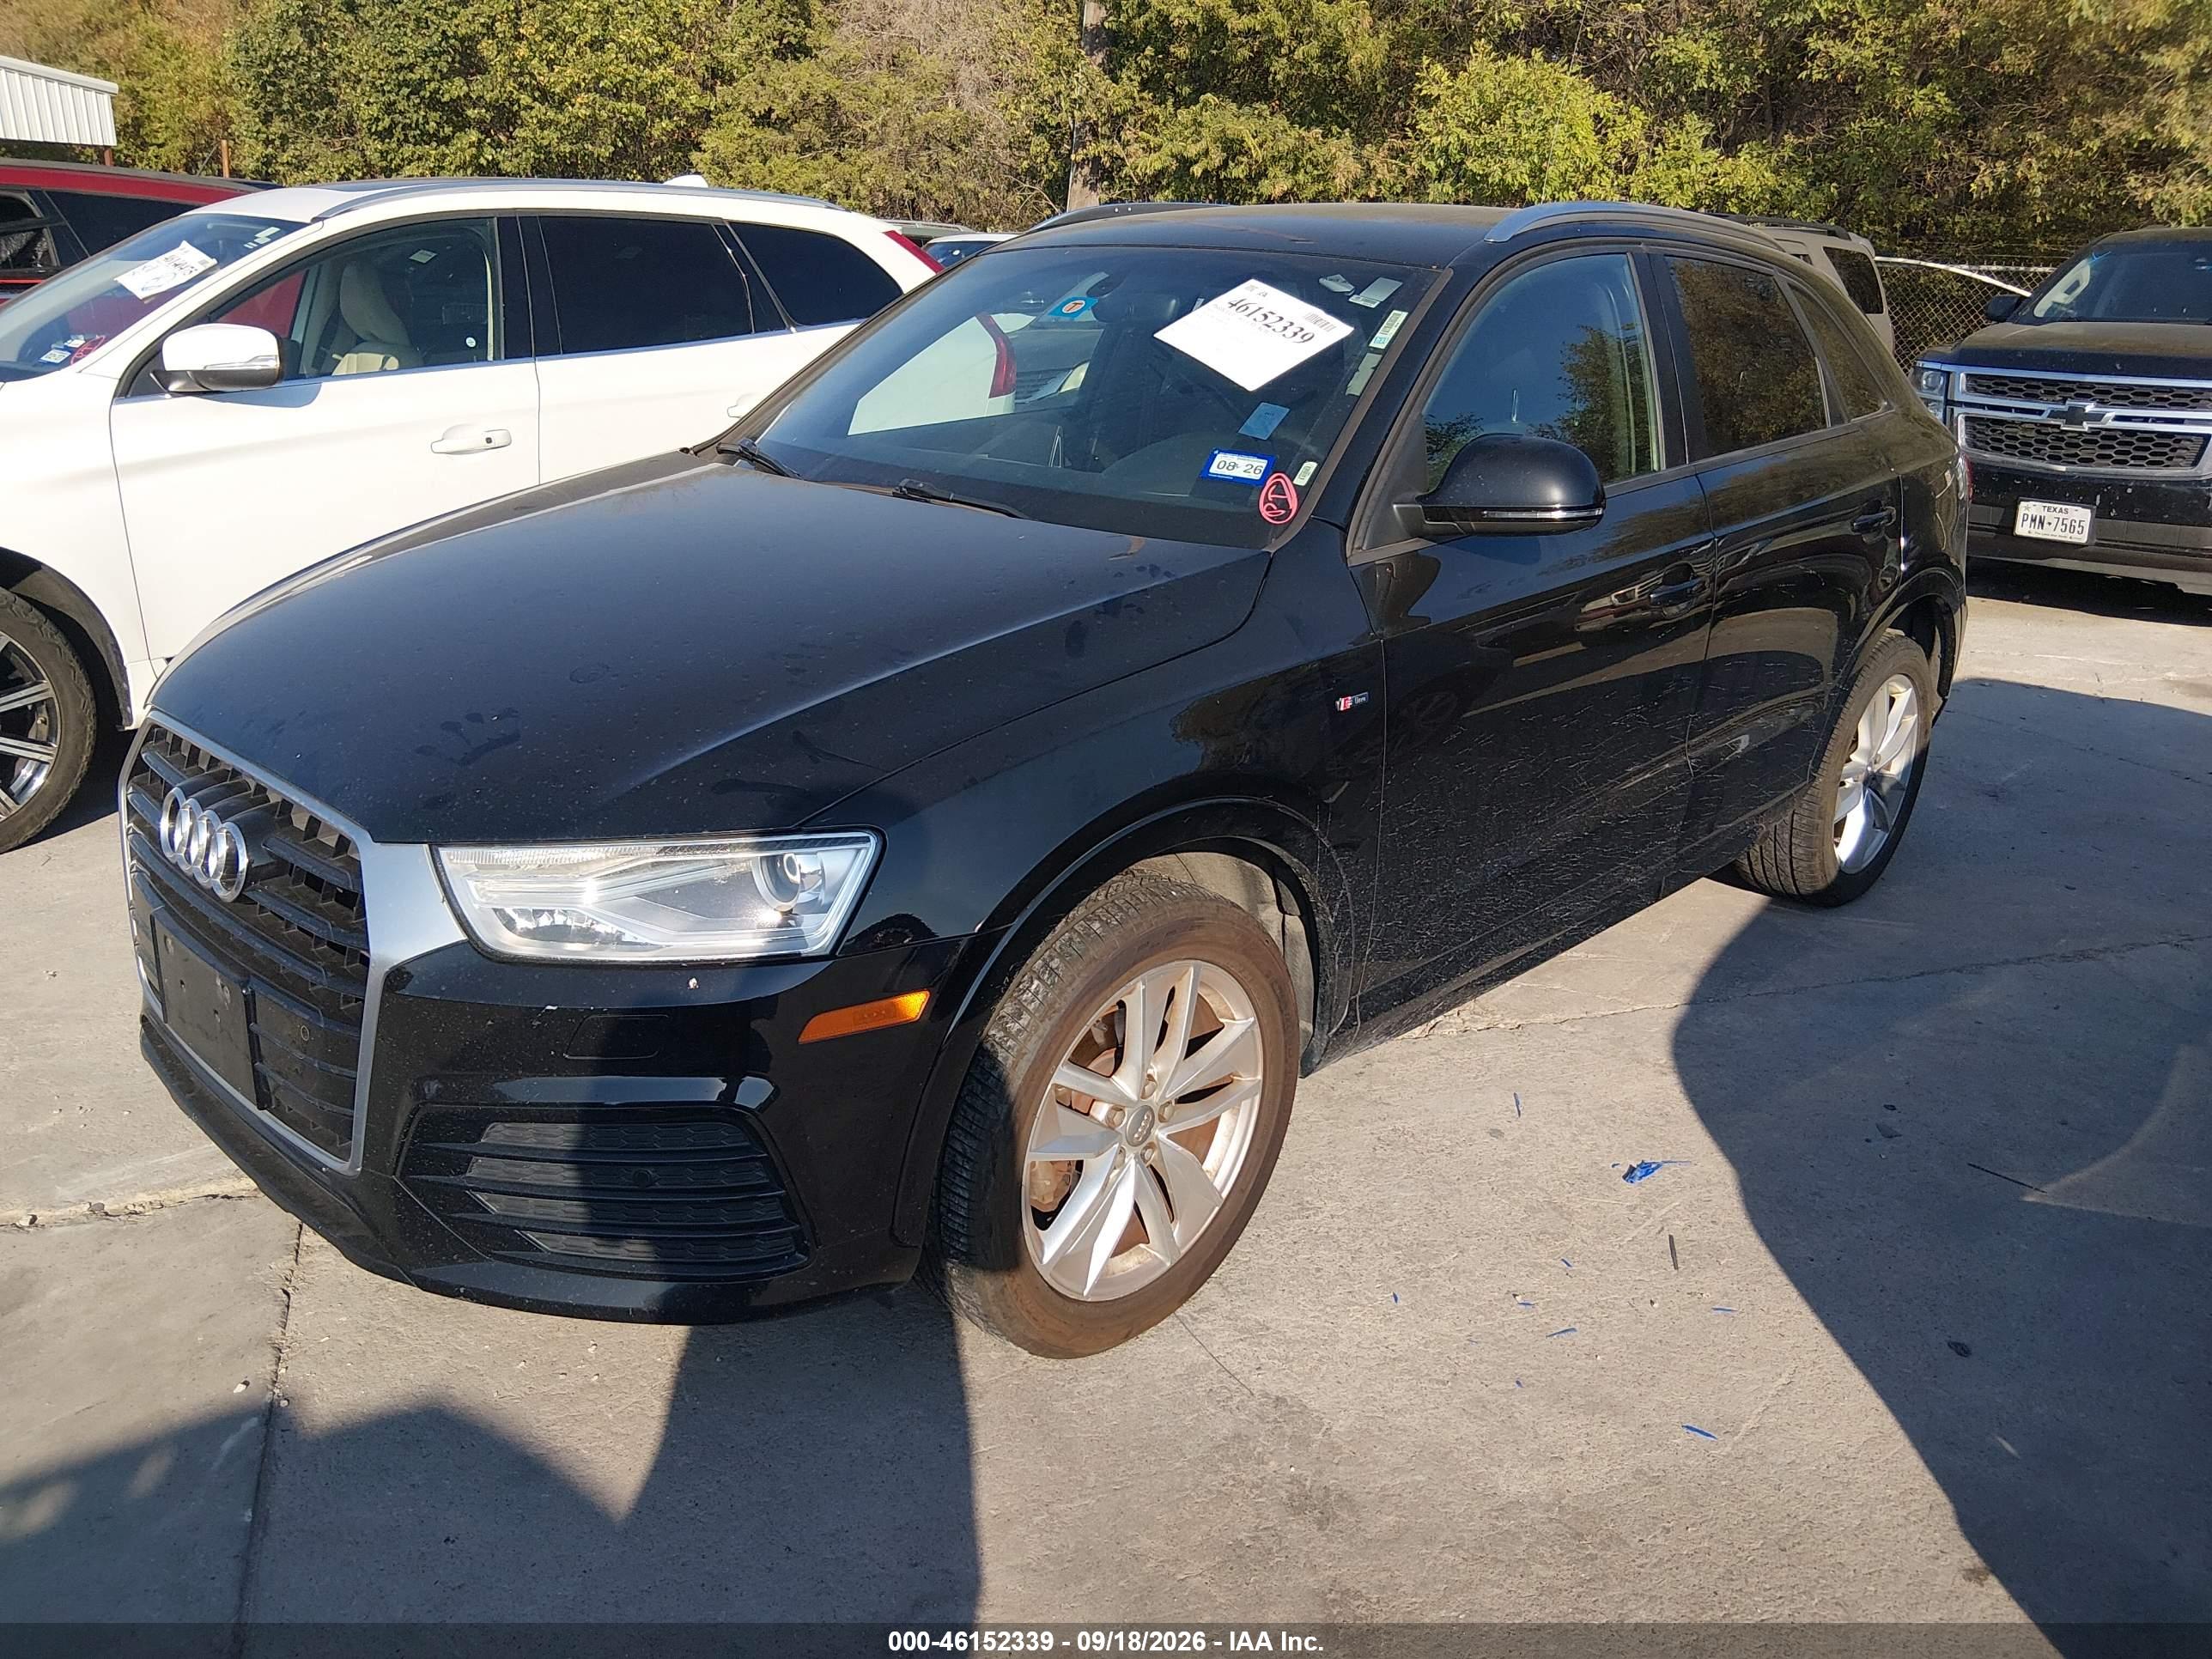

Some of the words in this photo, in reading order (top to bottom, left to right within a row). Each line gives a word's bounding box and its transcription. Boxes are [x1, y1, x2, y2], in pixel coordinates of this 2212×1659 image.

[1227, 298, 1316, 344] 46152339
[1216, 459, 1237, 471] 08
[1243, 464, 1264, 475] 26
[2042, 505, 2069, 514] TEXAS
